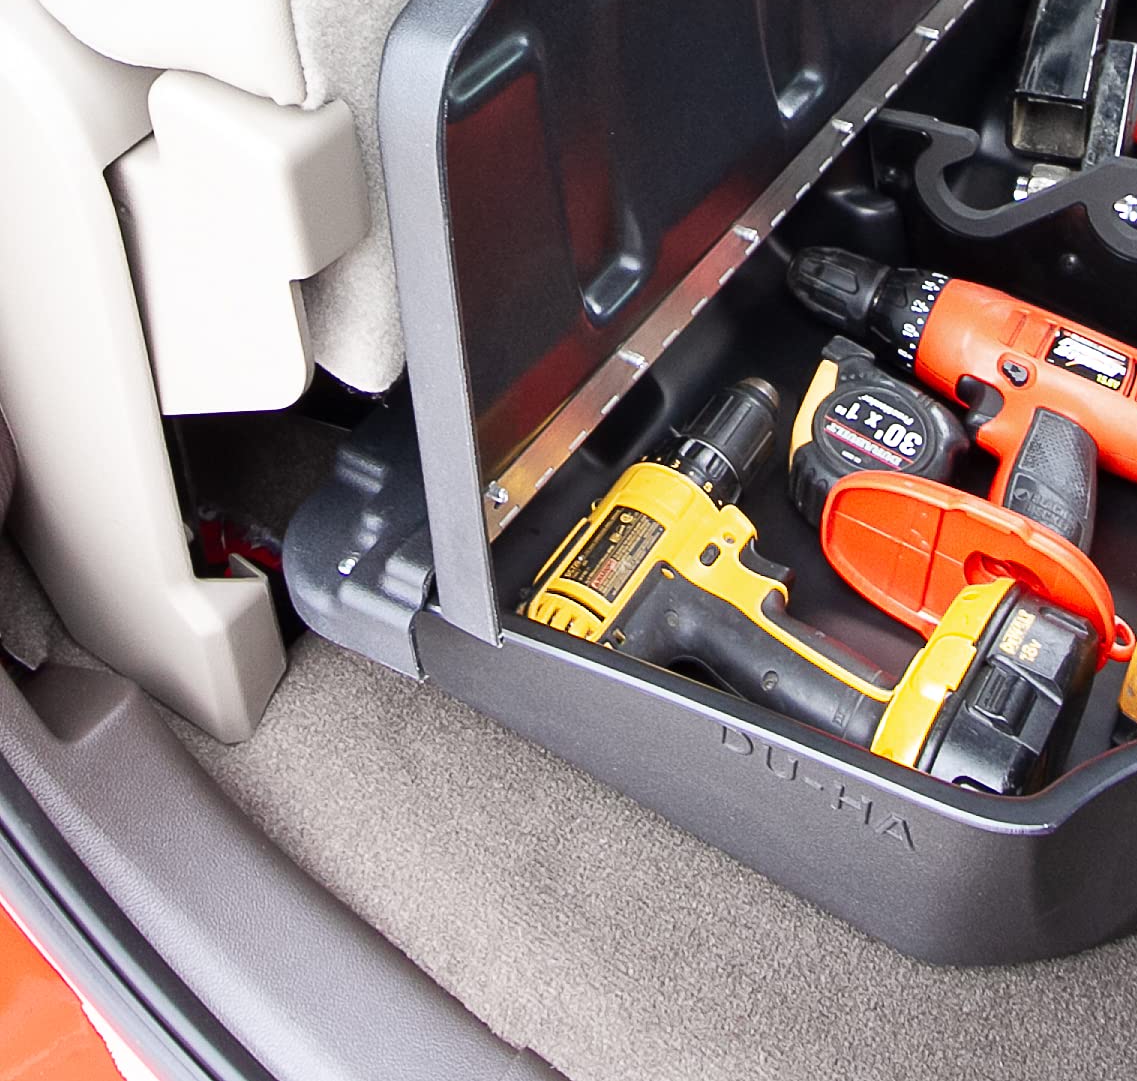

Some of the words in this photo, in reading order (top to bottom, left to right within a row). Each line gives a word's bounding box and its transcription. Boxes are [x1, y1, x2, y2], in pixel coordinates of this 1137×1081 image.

[911, 299, 930, 313] 12
[902, 323, 920, 338] 10
[873, 423, 923, 456] 30'
[721, 724, 915, 852] DU-HA
